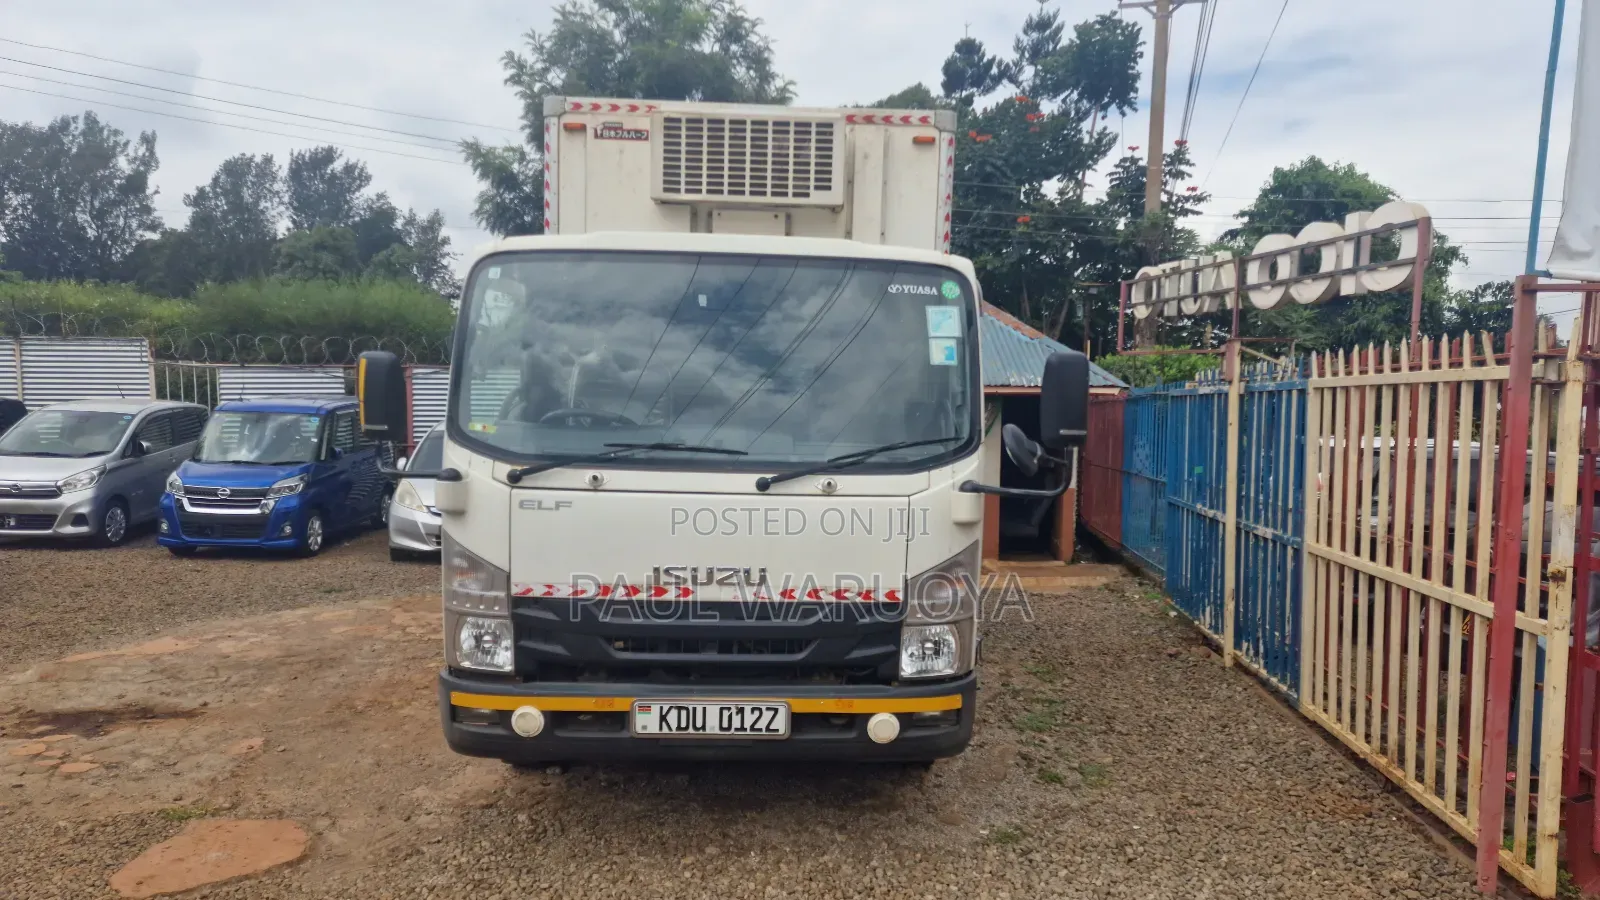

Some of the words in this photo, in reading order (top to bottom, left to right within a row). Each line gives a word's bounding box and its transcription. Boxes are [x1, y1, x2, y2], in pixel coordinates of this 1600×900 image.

[902, 285, 938, 295] YUASA
[519, 500, 572, 510] ELF
[652, 565, 767, 587] ISUZU
[658, 705, 707, 733] KDU
[718, 706, 780, 734] 012Z
